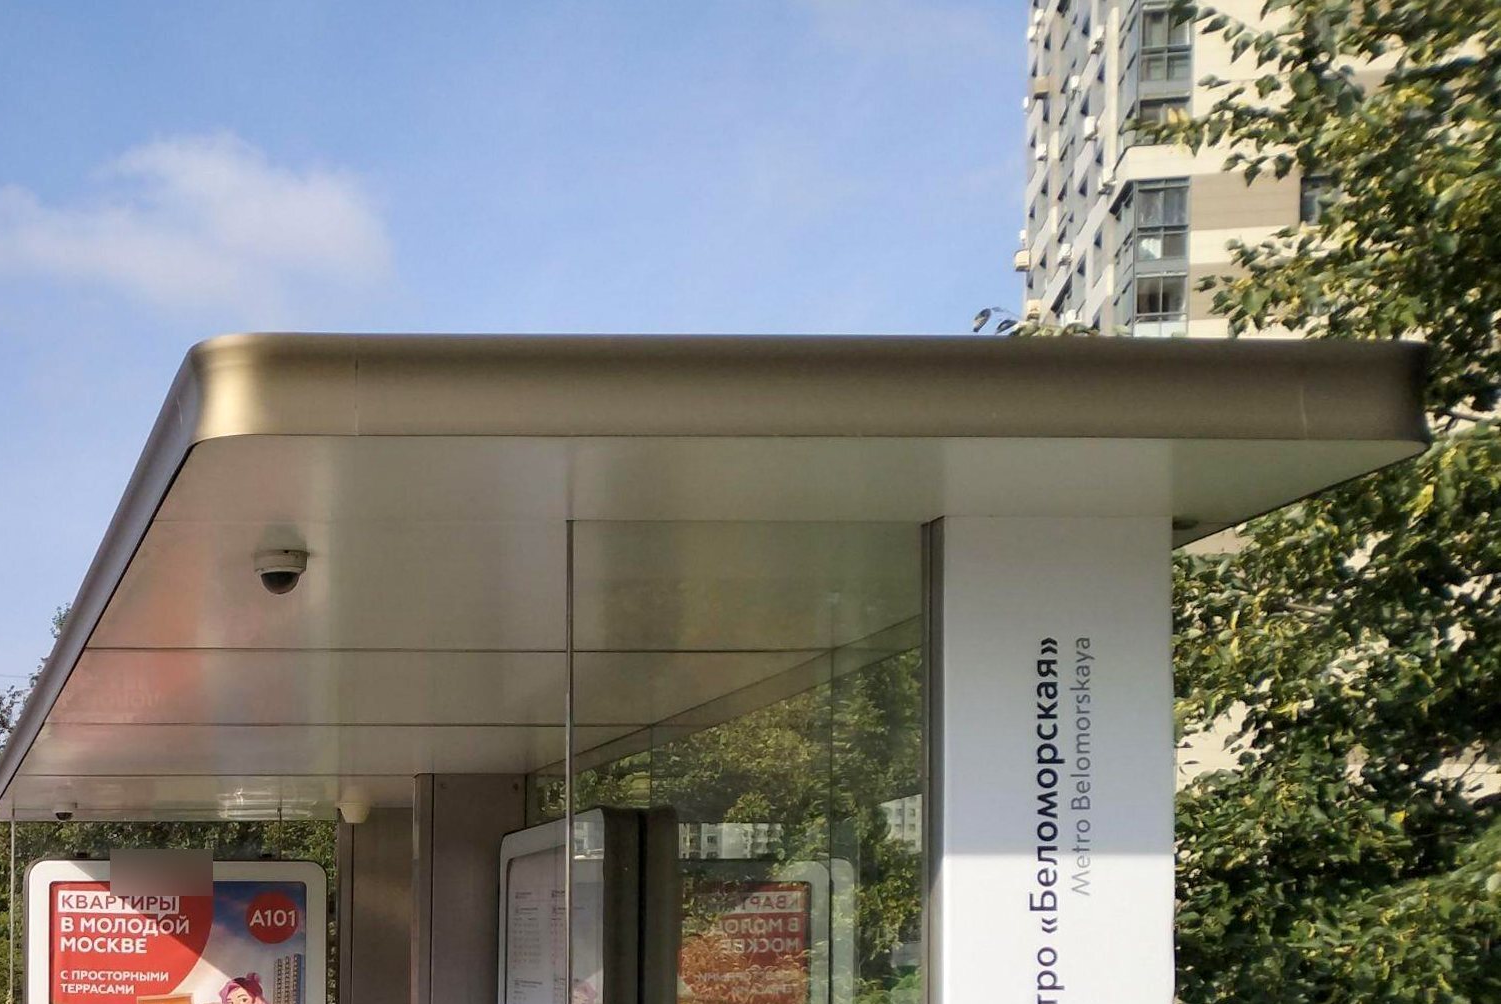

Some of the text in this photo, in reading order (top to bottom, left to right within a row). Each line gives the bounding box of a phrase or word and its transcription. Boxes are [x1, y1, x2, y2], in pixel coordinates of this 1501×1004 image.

[1070, 636, 1096, 896] Metro Belomorskaya
[1029, 636, 1065, 934] «Беломорская»
[61, 894, 176, 911] КВАРТИРЫ
[60, 915, 190, 936] В МОЛОДОЙ
[249, 909, 296, 927] А101
[60, 936, 148, 954] МОСКВЕ
[60, 970, 169, 982] С ПРОСТОРНЫМИ
[60, 983, 135, 994] ТЕРРАСАМИ
